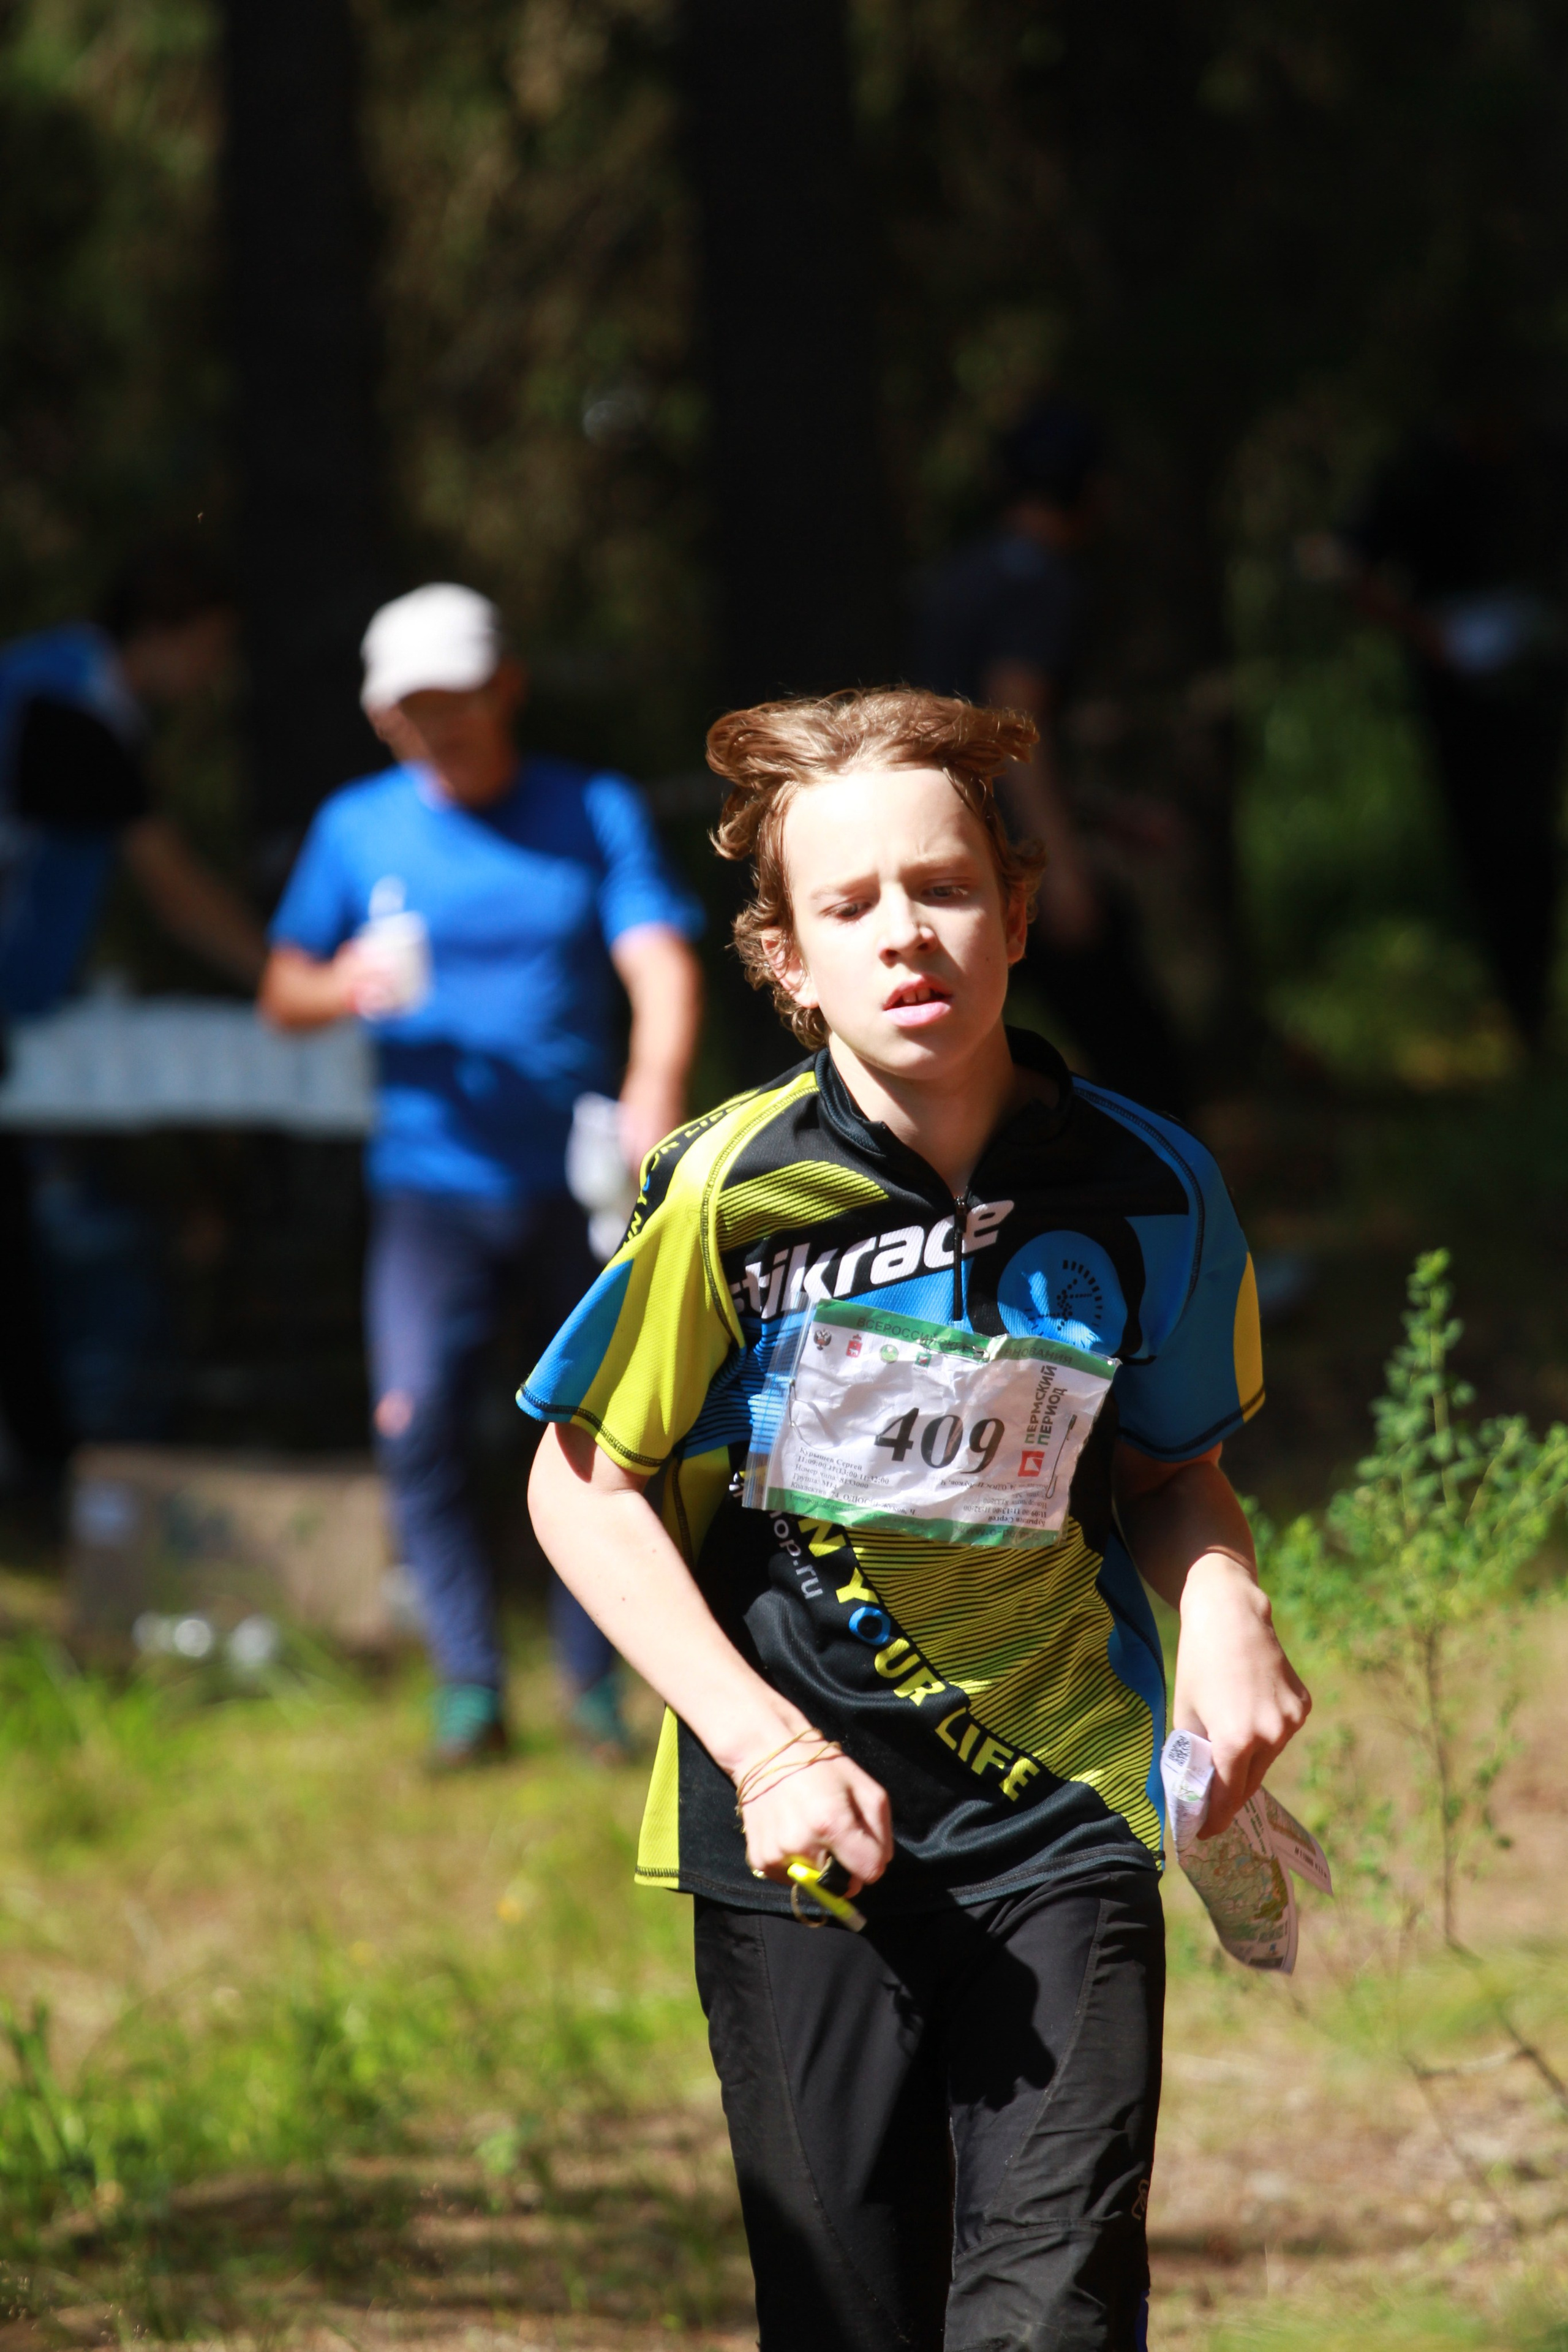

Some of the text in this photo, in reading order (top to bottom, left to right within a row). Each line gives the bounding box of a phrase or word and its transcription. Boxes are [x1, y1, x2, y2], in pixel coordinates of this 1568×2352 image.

[1024, 1365, 1057, 1444] ПЕРМСКИЙ
[1037, 1387, 1068, 1446] ПЕРИОД
[797, 1455, 889, 1485] 11:09:00 11:13:00 11:32:00
[799, 1447, 863, 1471] Курышев Сергей
[874, 1407, 1005, 1474] 409
[795, 1463, 818, 1477] Номер
[839, 1477, 869, 1490] 8133000
[797, 1517, 847, 1558] N
[835, 1567, 946, 1706] YOUR
[934, 1706, 1040, 1802] LIFE
